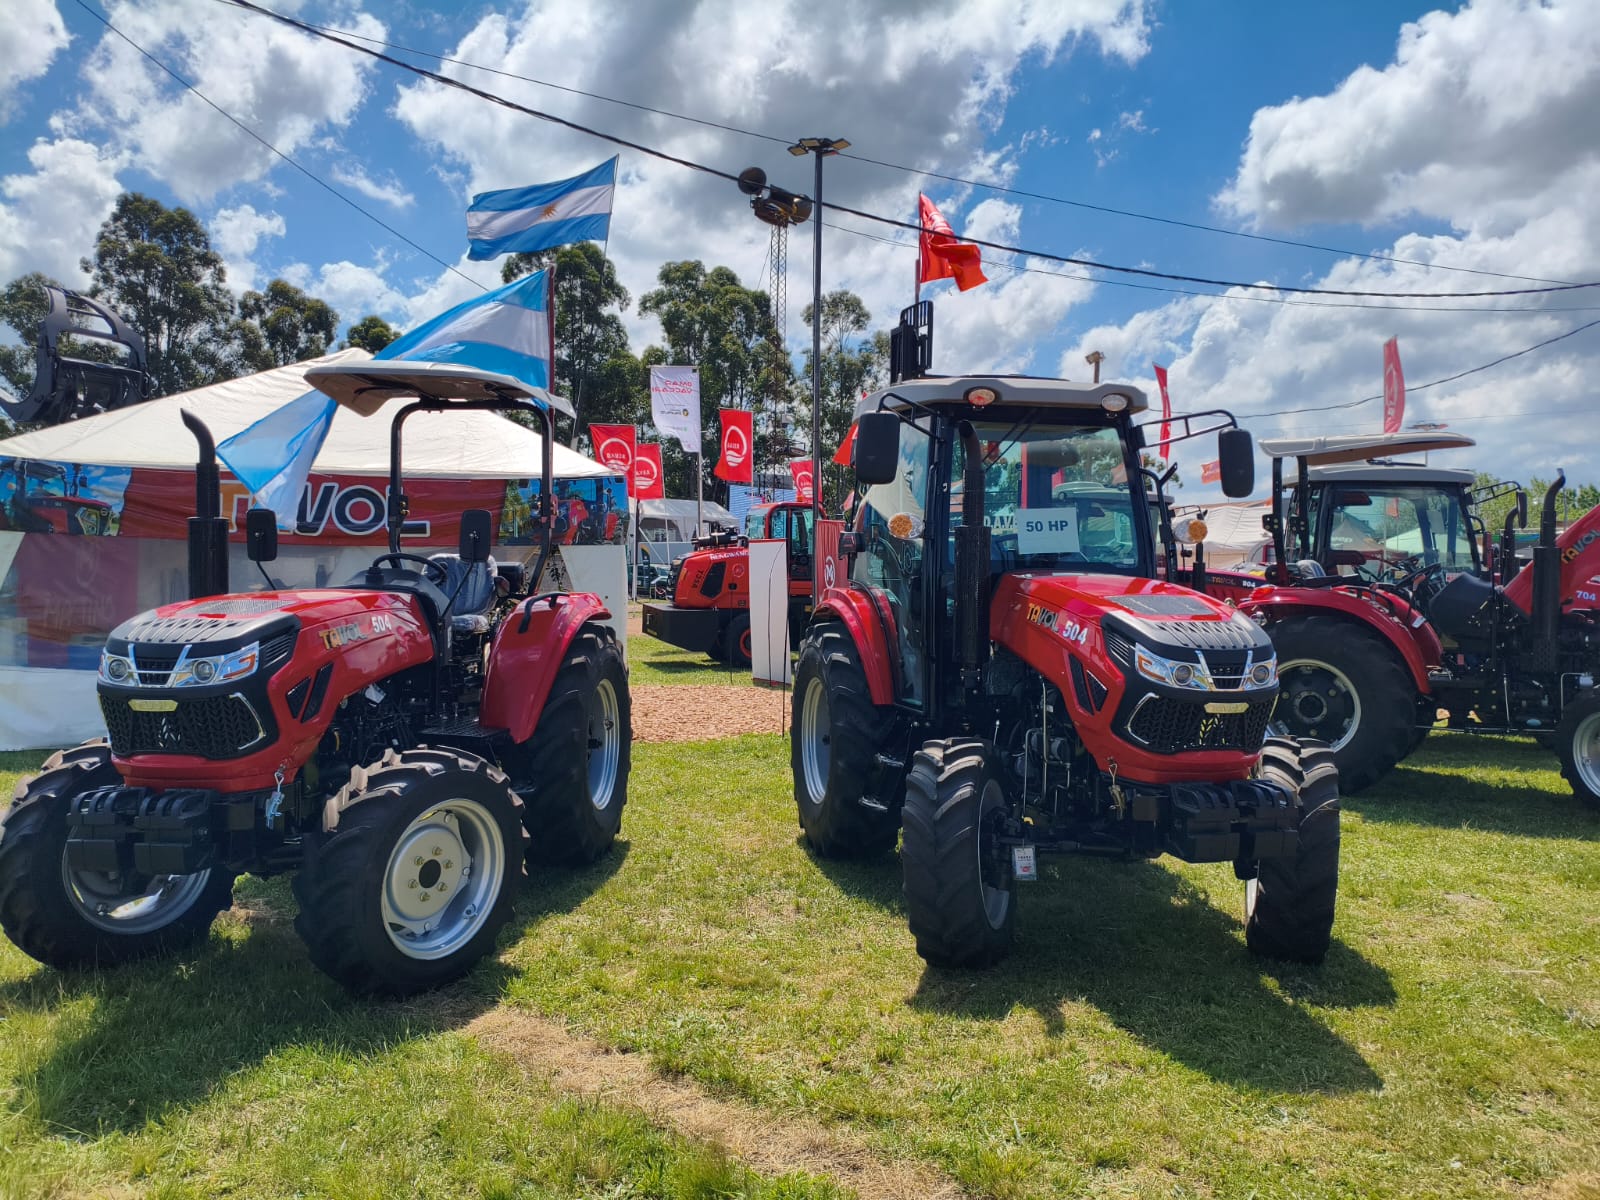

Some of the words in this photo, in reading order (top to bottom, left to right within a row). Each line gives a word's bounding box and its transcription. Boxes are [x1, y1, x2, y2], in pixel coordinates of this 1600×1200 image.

[219, 480, 430, 537] TVOL
[1026, 521, 1043, 532] 50
[1048, 520, 1068, 531] HP
[1576, 591, 1596, 601] 704
[319, 623, 368, 650] TAVOL
[371, 614, 392, 633] 504
[1026, 603, 1059, 633] TAVOL
[1062, 620, 1088, 645] 504
